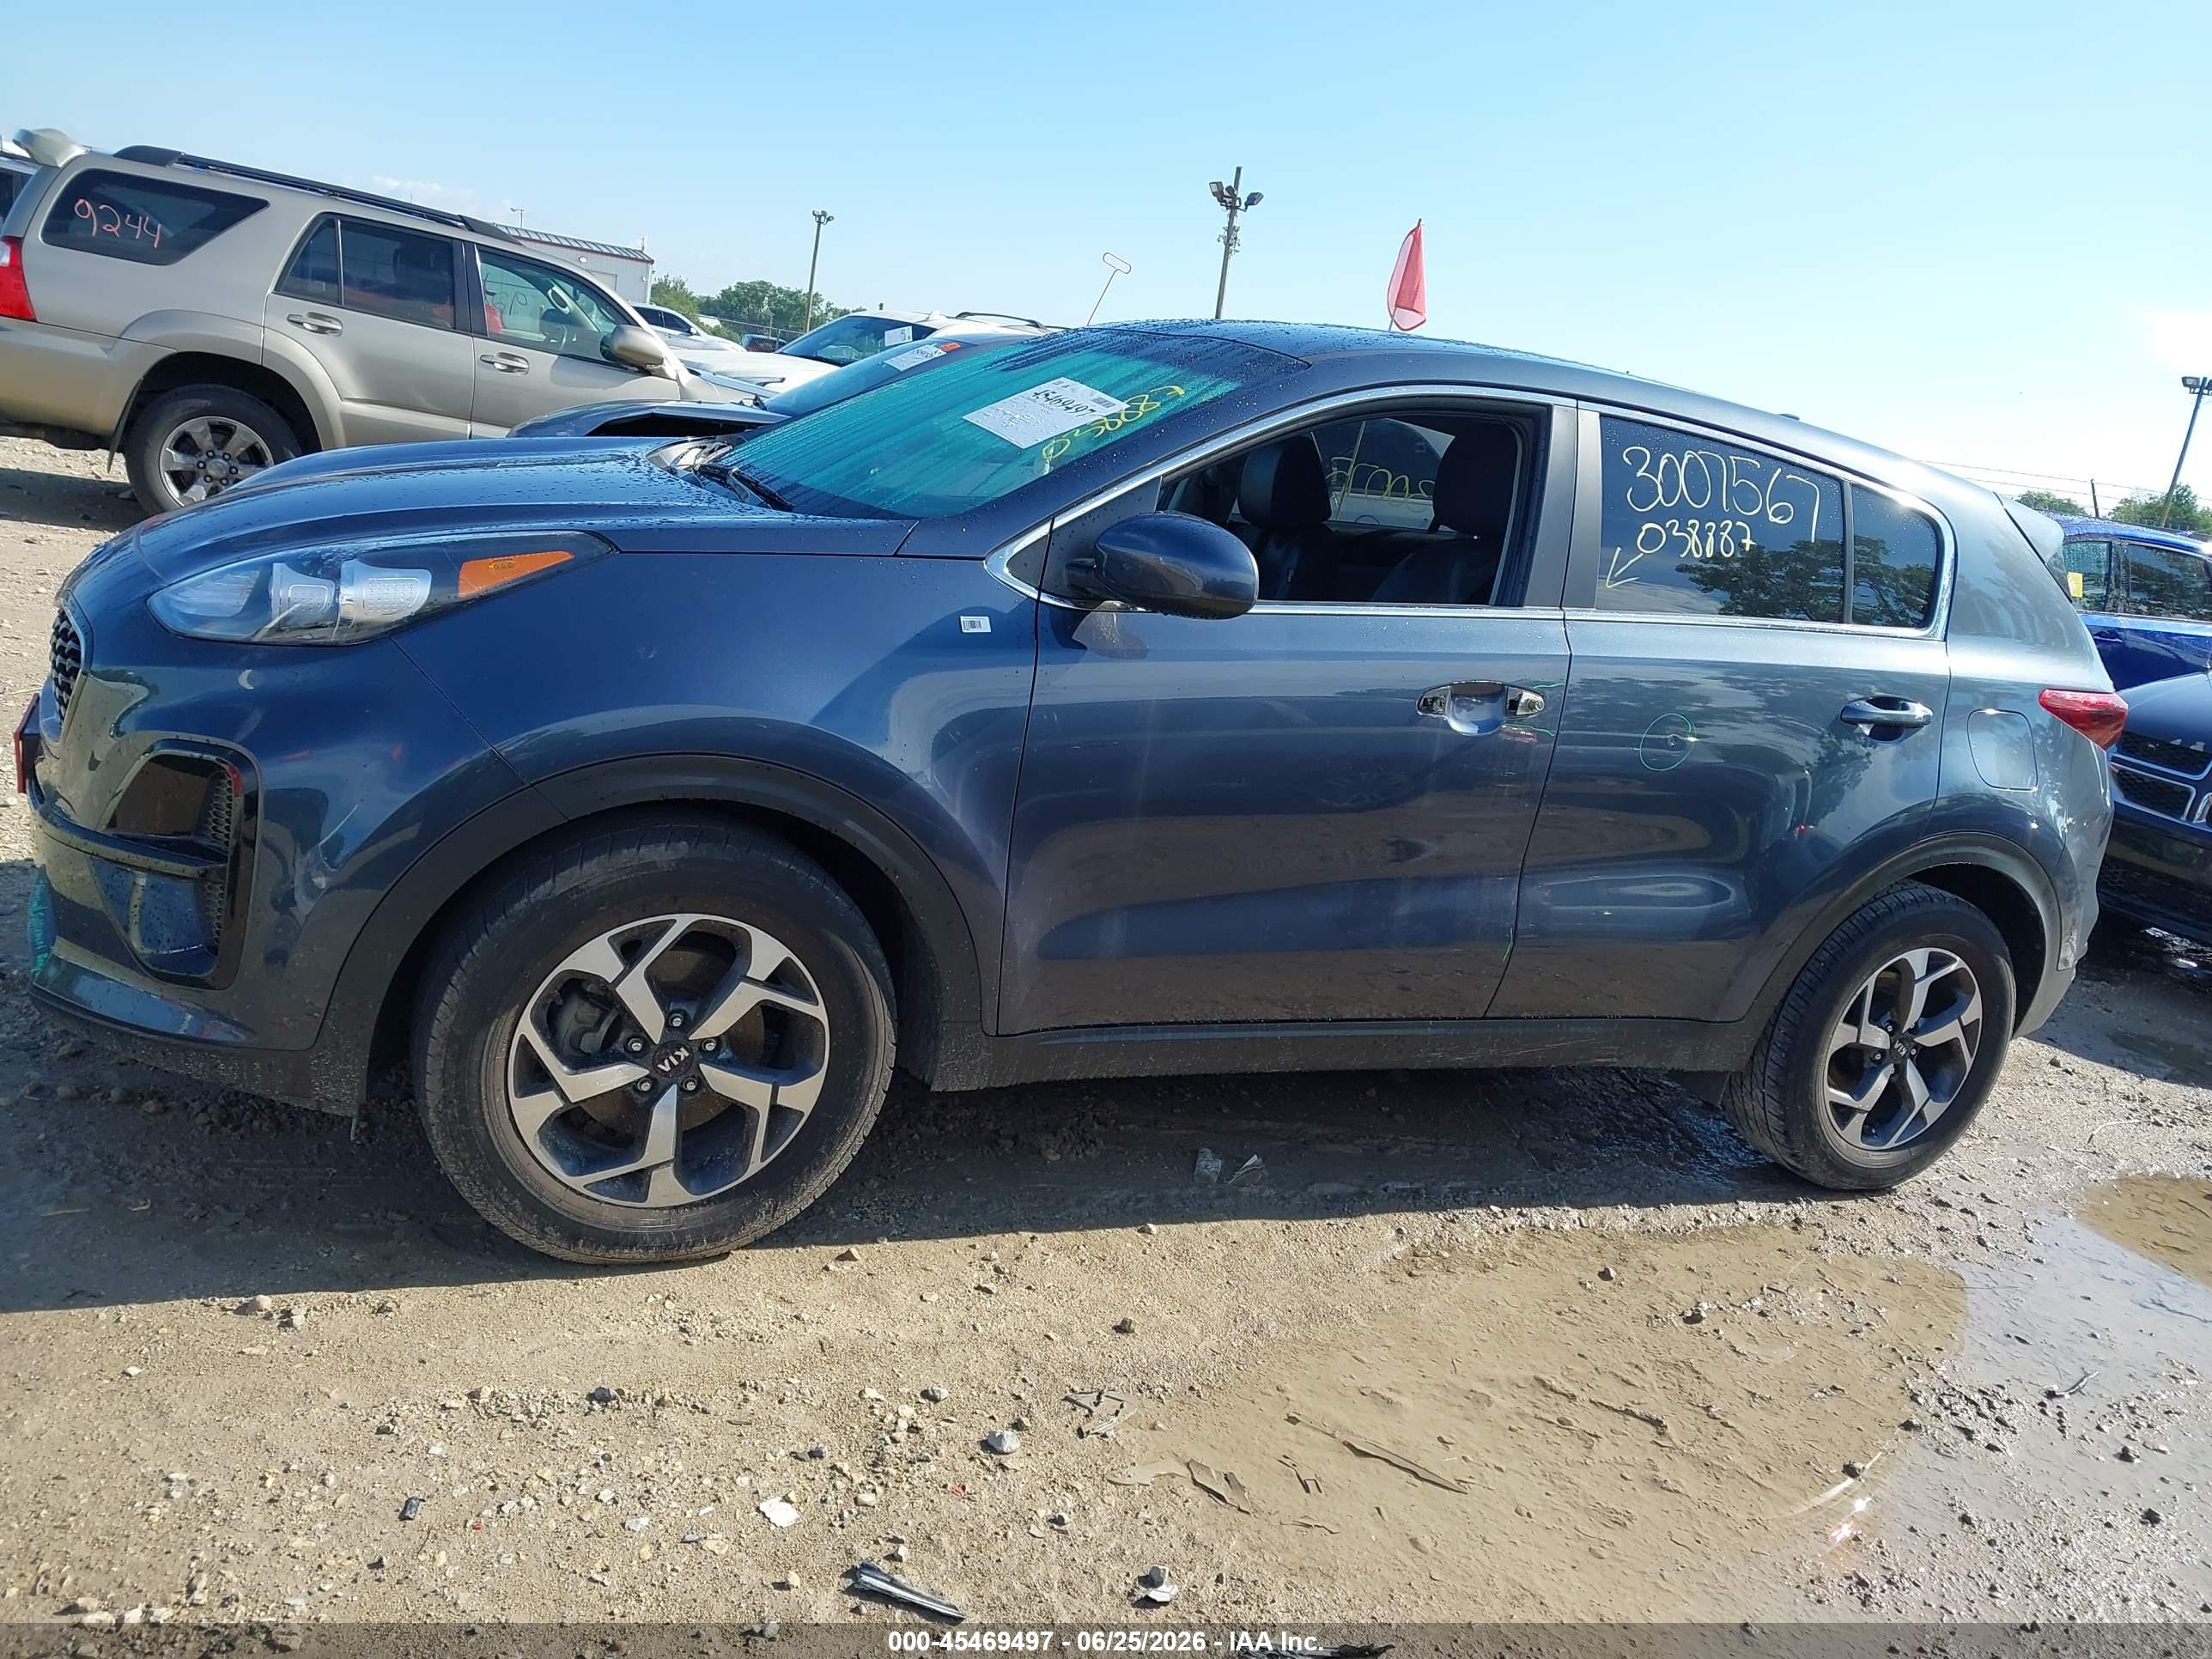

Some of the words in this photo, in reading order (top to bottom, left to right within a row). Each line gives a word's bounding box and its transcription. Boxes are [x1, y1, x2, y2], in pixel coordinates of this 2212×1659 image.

[74, 198, 161, 249] 9244
[1031, 389, 1097, 418] 45469497
[1622, 446, 1820, 543] 3007567
[1637, 519, 1756, 558] 038887
[657, 1047, 690, 1072] KIA
